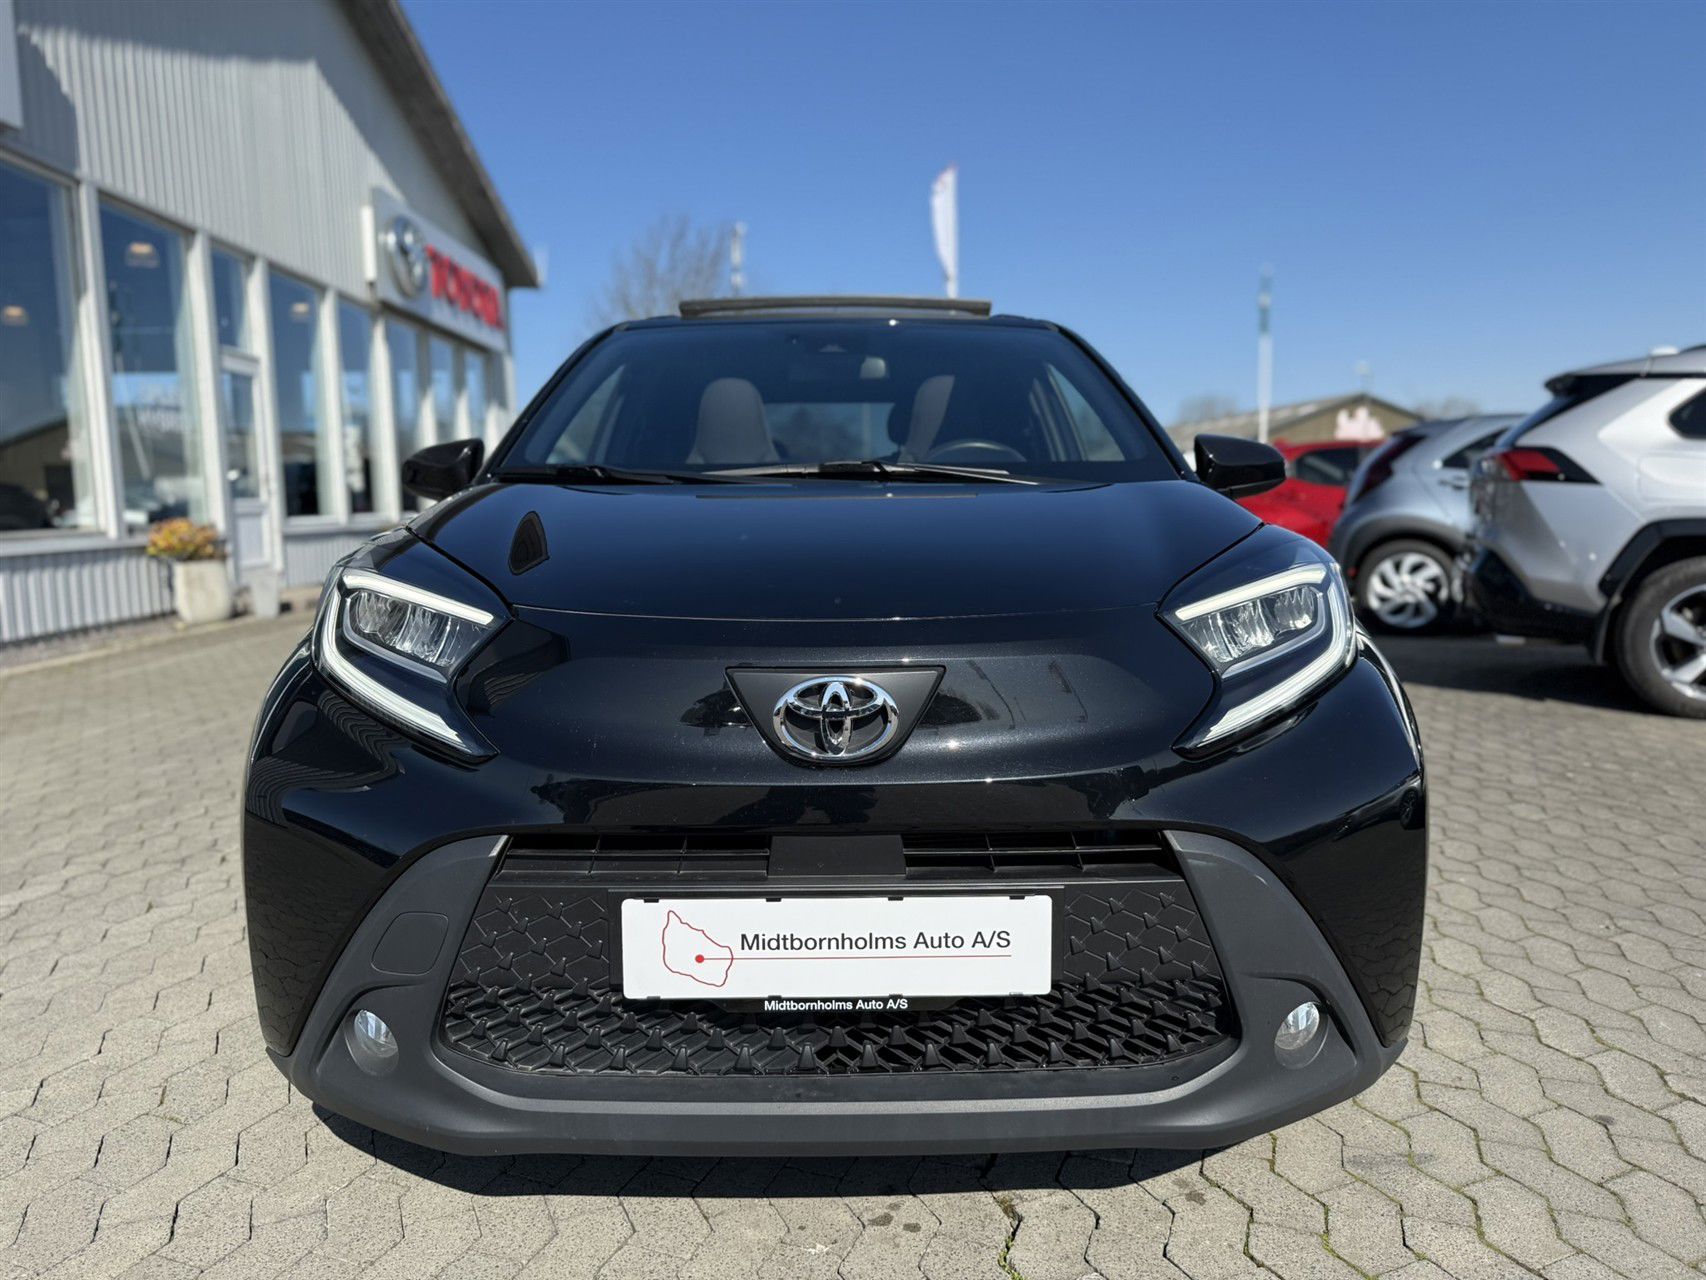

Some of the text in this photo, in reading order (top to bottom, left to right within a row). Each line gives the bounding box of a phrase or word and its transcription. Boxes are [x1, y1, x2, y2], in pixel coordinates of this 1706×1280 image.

[740, 930, 1011, 951] Midtbornholms Auto A/S
[764, 998, 908, 1011] Midtbornholms Auto A/S
